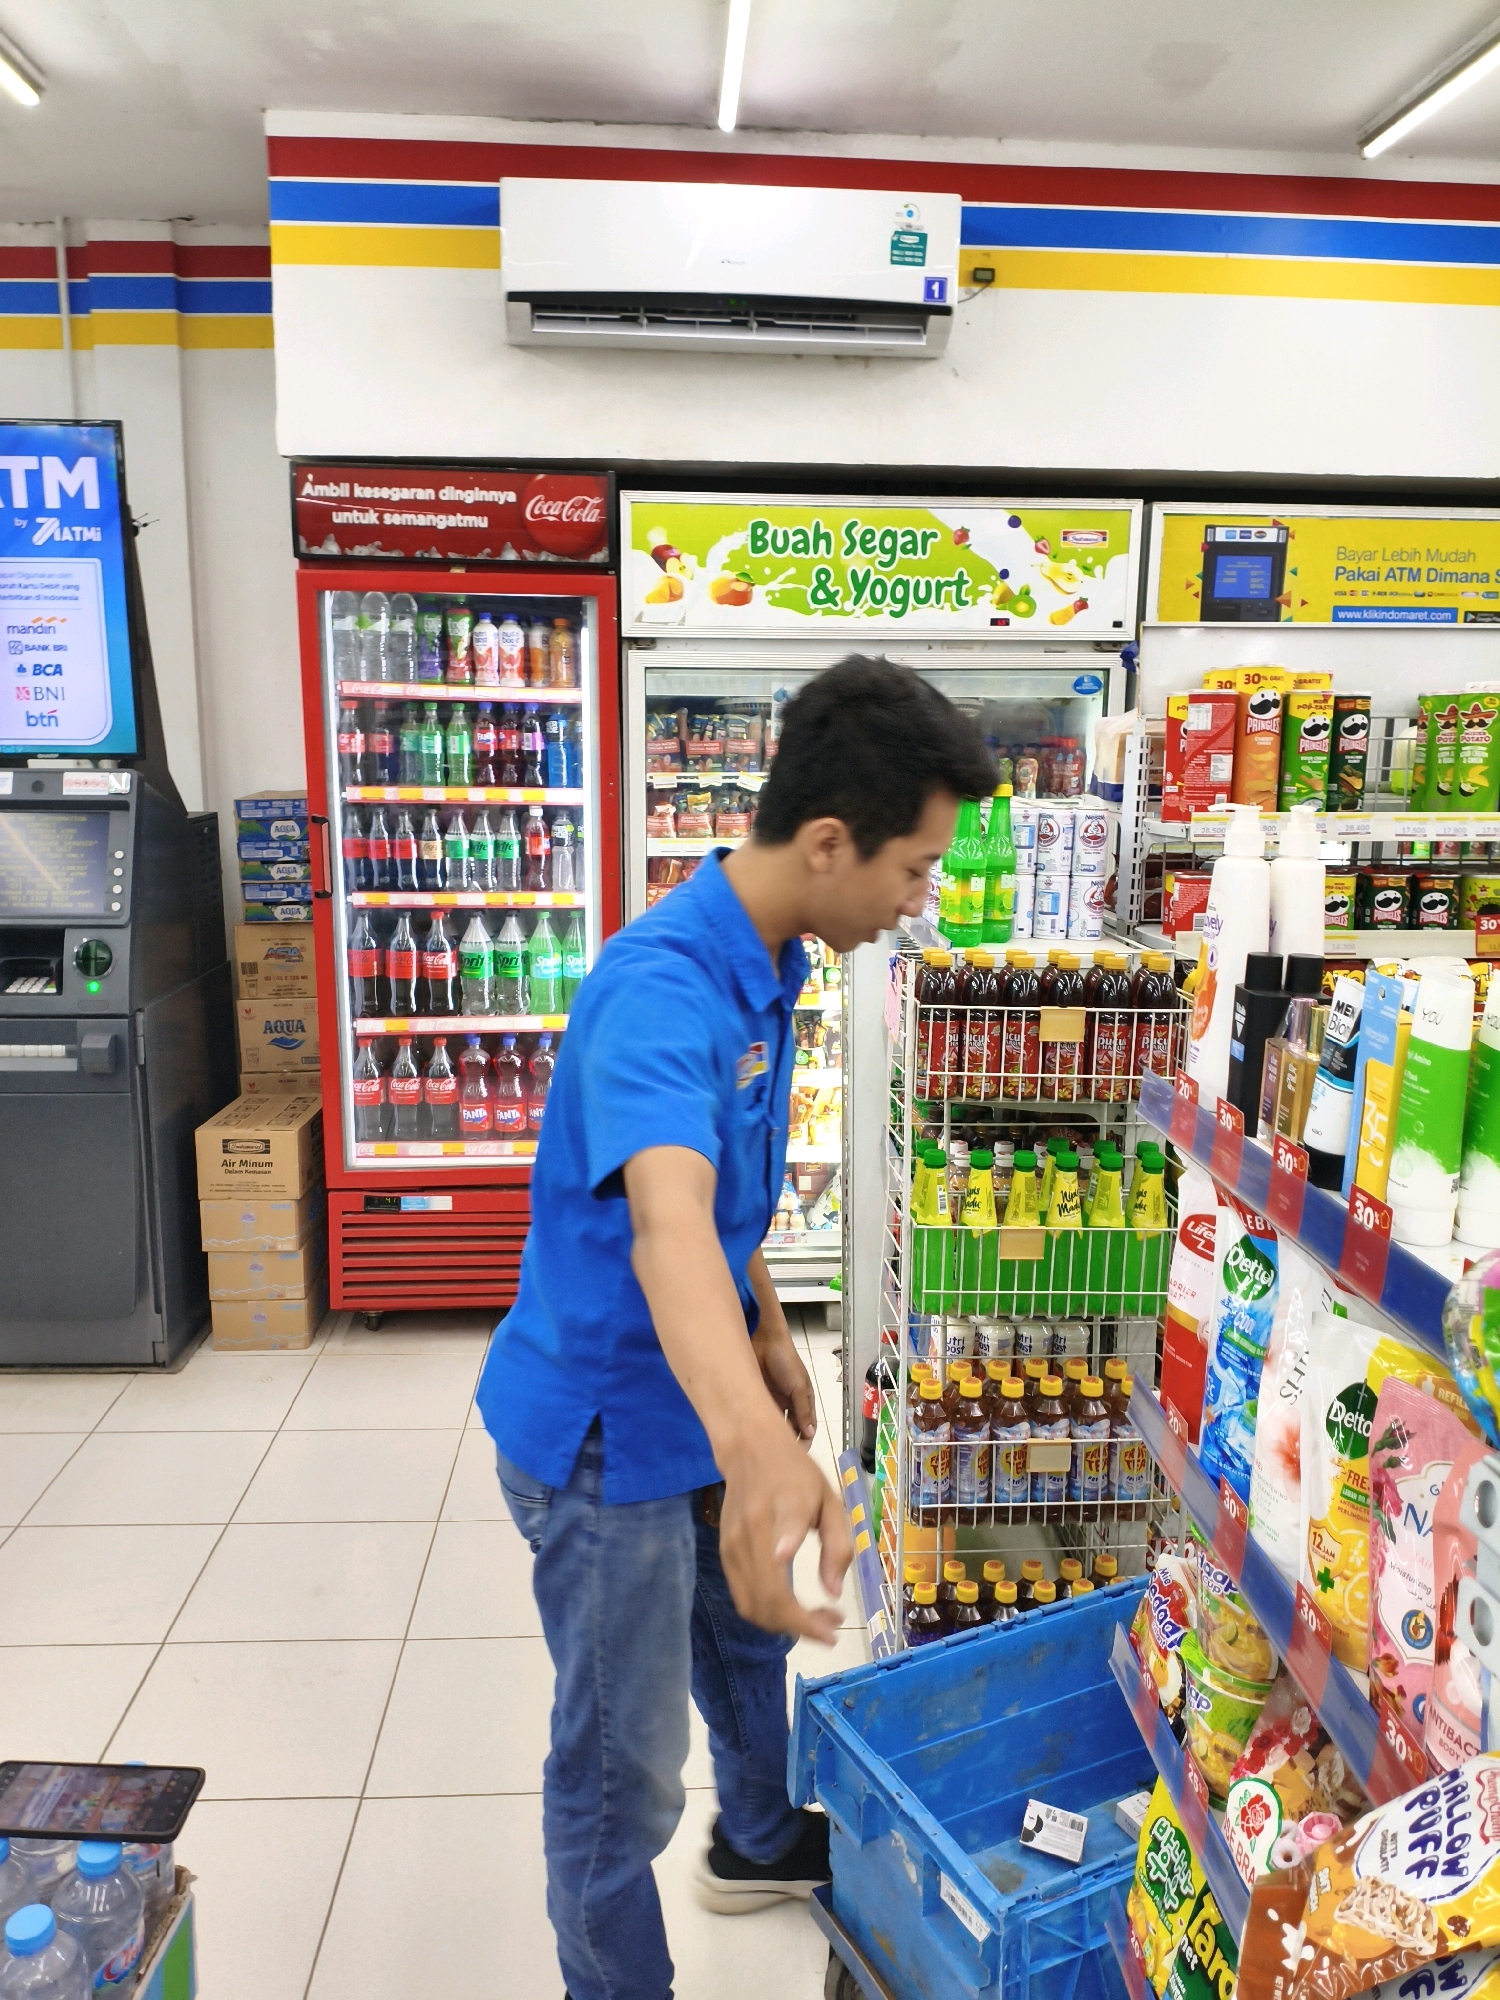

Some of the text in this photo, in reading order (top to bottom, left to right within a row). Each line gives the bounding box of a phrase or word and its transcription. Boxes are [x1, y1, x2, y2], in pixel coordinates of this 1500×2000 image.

[931, 282, 940, 298] 1
[0, 456, 100, 509] TM
[302, 480, 517, 505] Ambil kesegaran dinginnya
[525, 494, 604, 523] Coca-Cola
[14, 517, 29, 529] by
[332, 509, 489, 530] untuk semangatmu
[750, 520, 938, 568] Buah Segar
[1336, 546, 1476, 564] Bayar Lebih Mudah
[1334, 566, 1490, 584] Pakai ATM Dimana
[810, 567, 970, 619] & Yogurt
[1337, 609, 1452, 621] www.klikindomaret.com
[7, 622, 57, 635] mandiri
[24, 644, 51, 652] BANK
[32, 663, 64, 677] BCA
[33, 686, 66, 701] BNI
[25, 710, 59, 728] btn
[1246, 716, 1280, 734] PRINGLES
[1299, 737, 1330, 753] PRINGLES
[1338, 737, 1368, 752] PRINGLES
[1460, 735, 1491, 743] POTATO
[274, 825, 297, 835] AQUA
[276, 865, 298, 875] AQUA
[280, 907, 301, 916] AQUA
[1373, 909, 1401, 922] PRINGLES
[1419, 912, 1448, 925] PRINGLES
[1325, 915, 1349, 927] RINGLES
[1421, 1008, 1444, 1026] YOU
[263, 1019, 307, 1036] AQUA
[390, 1078, 421, 1092] Coca-Cola
[425, 1078, 457, 1092] Coca-Cola
[462, 1108, 488, 1121] FANTA
[496, 1108, 521, 1121] FANTA
[1219, 1107, 1237, 1132] 30%
[221, 1159, 274, 1169] Air Minum
[1277, 1147, 1297, 1174] 30%
[1353, 1199, 1380, 1231] 30%
[1226, 1245, 1275, 1288] Dettol
[1329, 1401, 1373, 1438] Detto
[1223, 1489, 1241, 1519] 30%
[1312, 1531, 1336, 1560] 12 JAM
[1159, 1567, 1172, 1586] Mie
[1202, 1575, 1222, 1595] Cup
[1301, 1598, 1322, 1633] 30%
[1385, 1719, 1413, 1763] 30%
[1438, 1737, 1461, 1764] BODY
[1187, 1764, 1203, 1795] 25%
[1438, 1765, 1472, 1877] MALLOW
[1404, 1785, 1443, 1880] PUFF
[1179, 1933, 1199, 1971] net
[1187, 1891, 1239, 2000] Taro
